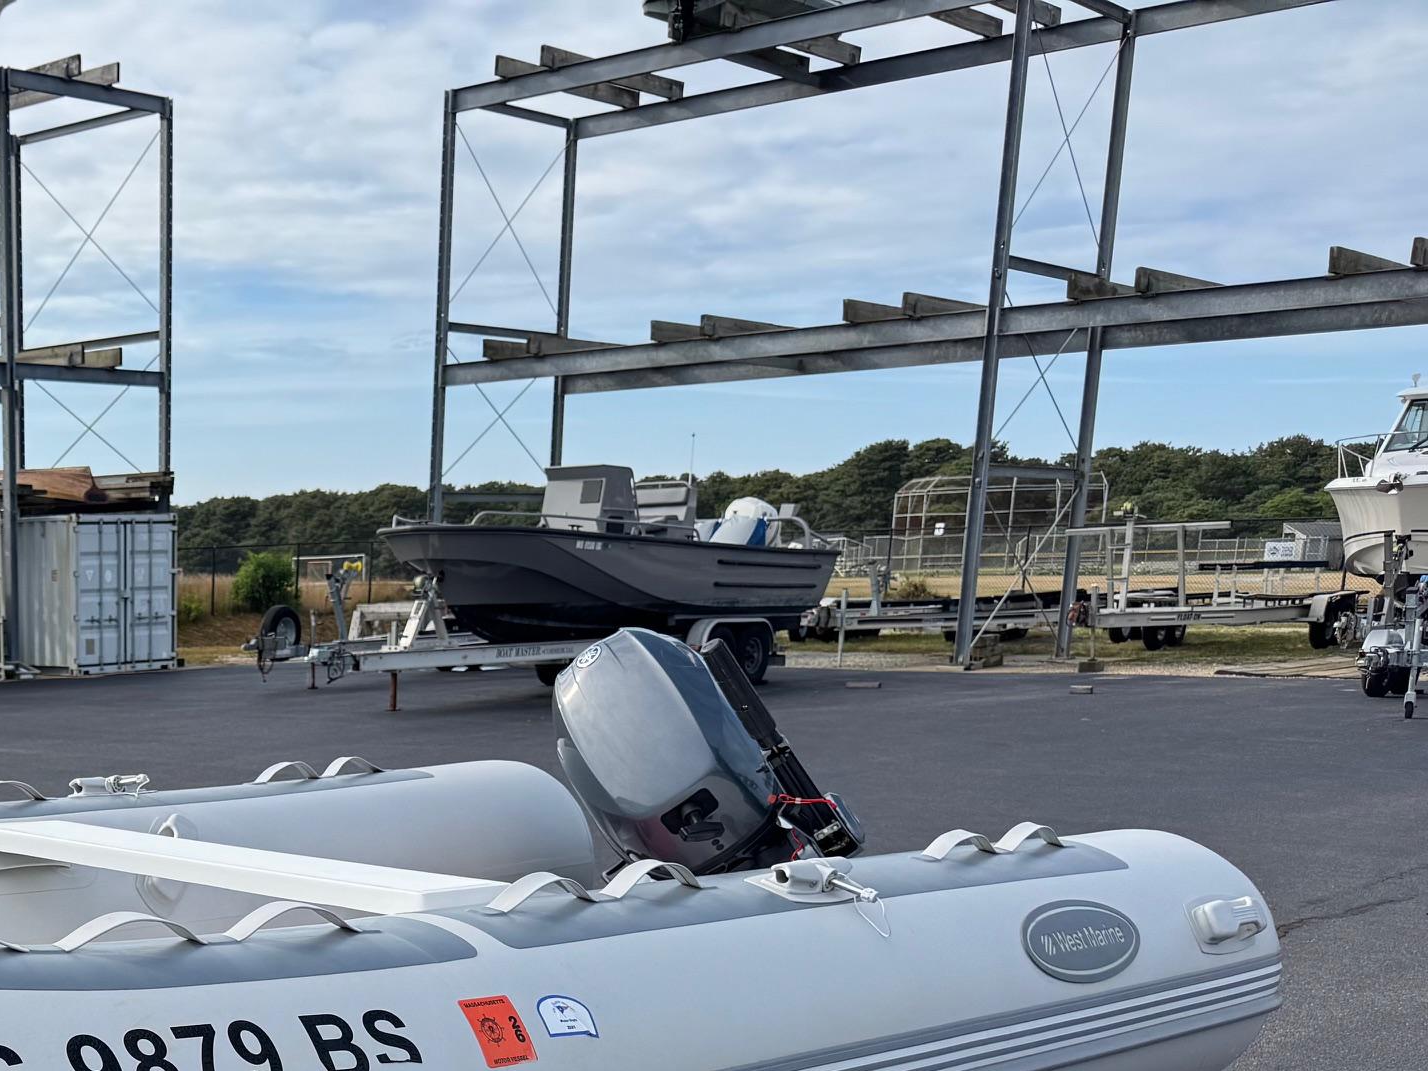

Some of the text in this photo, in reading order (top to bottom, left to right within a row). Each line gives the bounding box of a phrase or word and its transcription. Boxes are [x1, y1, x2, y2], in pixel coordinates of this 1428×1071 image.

[1055, 924, 1125, 953] West Marine
[463, 999, 505, 1008] MASSACHUSETTS
[508, 1015, 526, 1043] 26
